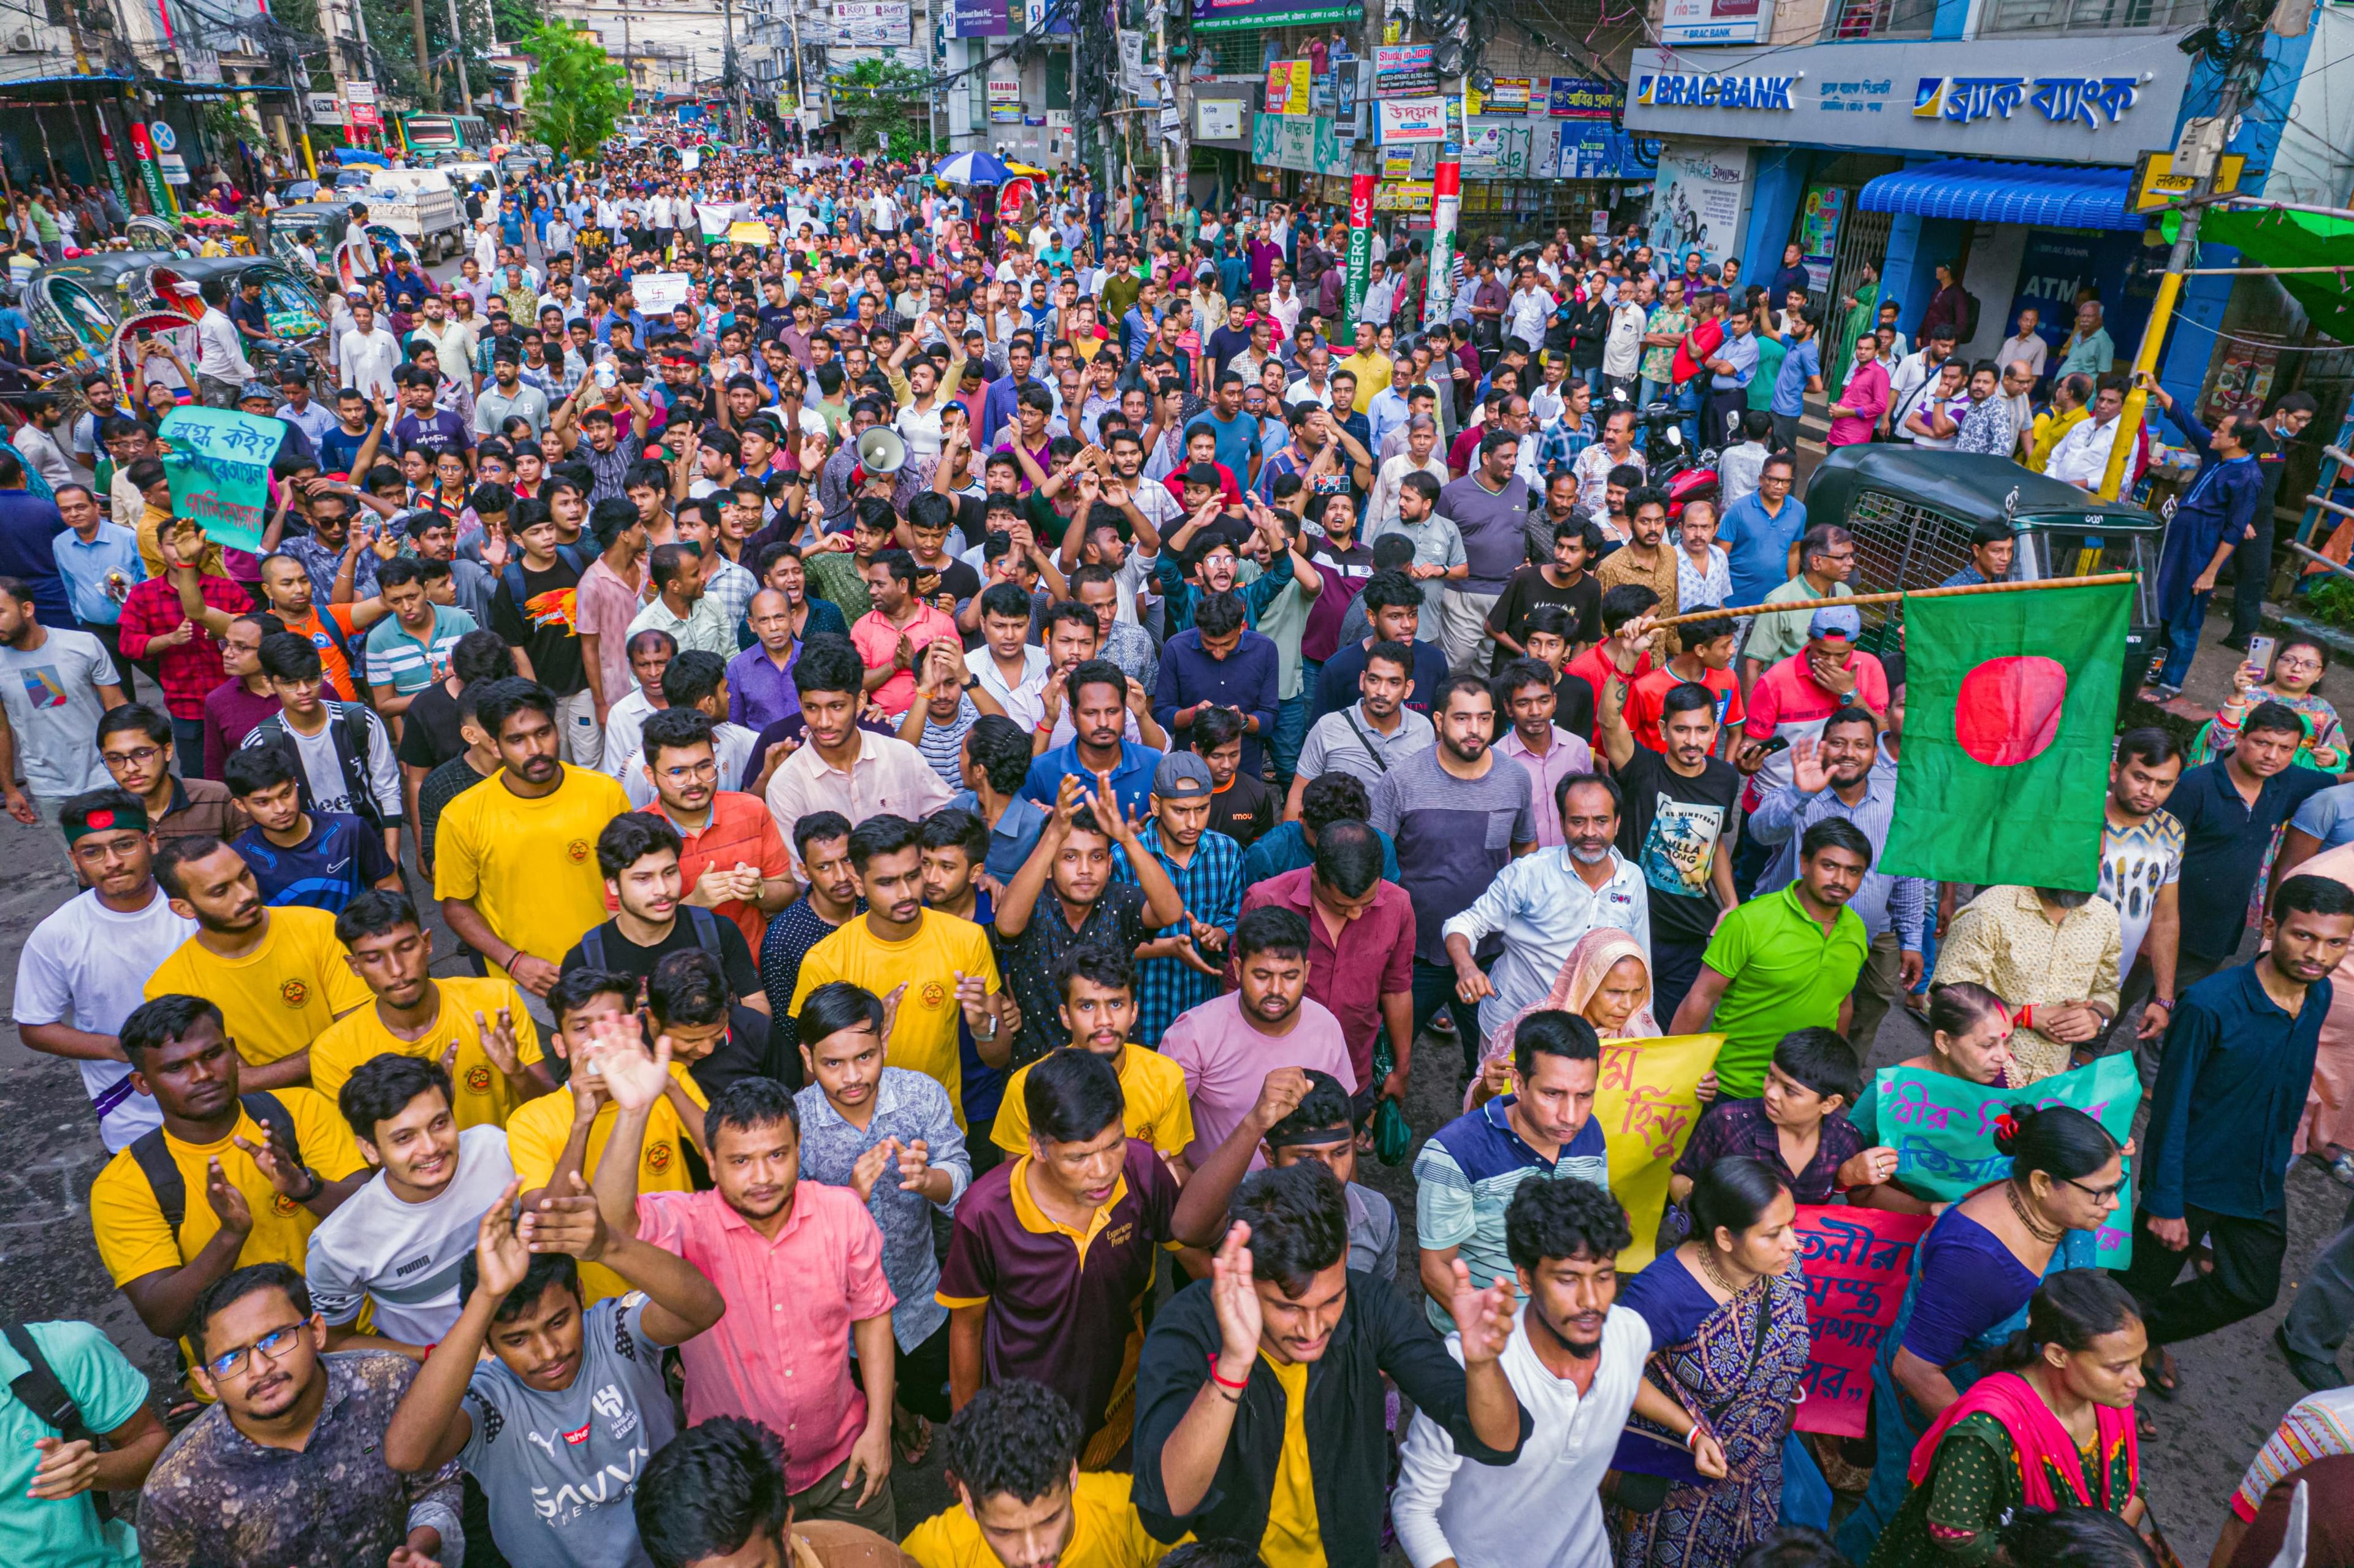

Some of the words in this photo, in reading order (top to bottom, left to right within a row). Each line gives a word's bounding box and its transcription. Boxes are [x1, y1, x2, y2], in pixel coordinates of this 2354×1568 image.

[1689, 29, 1708, 38] BRAC
[1710, 28, 1732, 37] BANK
[1379, 51, 1402, 61] Study
[1412, 49, 1433, 59] JAP
[989, 82, 1018, 91] SHADIA
[1657, 75, 1721, 105] BRAC
[1720, 77, 1794, 108] BANK
[1567, 89, 1593, 107] আবির
[1594, 94, 1624, 108] প্রকান
[1945, 77, 2027, 123] ব্র্যাক
[2030, 77, 2138, 129] ব্যাংক
[1387, 102, 1439, 121] উদয়ন
[1285, 122, 1313, 139] জান্নাত
[133, 141, 159, 192] NEROLAC
[1684, 162, 1711, 178] TARA
[2155, 174, 2188, 188] লকার
[1350, 197, 1369, 280] NEROLAC
[2022, 275, 2081, 305] ATM
[221, 420, 277, 460] কই?
[416, 434, 449, 444] adventure
[1888, 1081, 1969, 1130] বীর
[1621, 1085, 1693, 1159] হিন্দু
[396, 1254, 431, 1277] PUMA
[610, 1408, 632, 1431] ALHILAL
